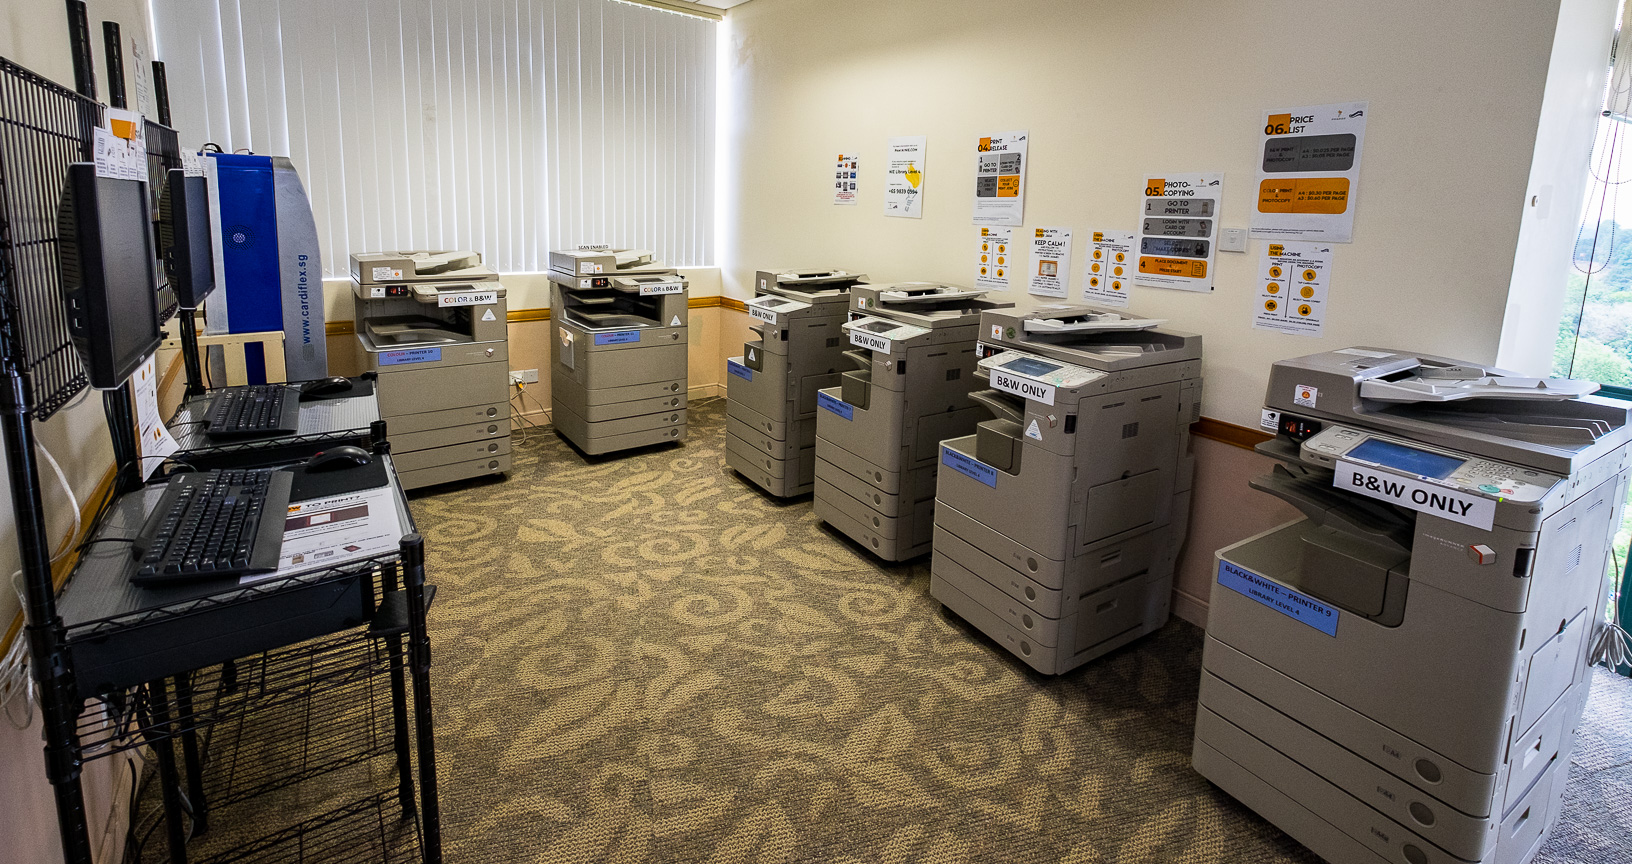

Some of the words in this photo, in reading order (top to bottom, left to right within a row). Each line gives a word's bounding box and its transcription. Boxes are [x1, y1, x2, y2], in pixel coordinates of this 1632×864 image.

[1265, 124, 1287, 135] 06.
[1145, 187, 1162, 196] 05.
[298, 254, 311, 344] www.cardiflex.sg
[752, 309, 762, 318] B&W
[762, 313, 773, 321] ONLY
[855, 335, 869, 345] B&W
[870, 339, 886, 349] ONLY
[997, 376, 1020, 390] B&W
[1021, 383, 1046, 398] ONLY
[946, 450, 970, 465] BLACK&WHITE
[974, 464, 990, 475] PRINTER
[324, 496, 360, 505] PRINT?
[1352, 472, 1405, 498] B&W
[1411, 489, 1473, 517] ONLY
[1225, 565, 1280, 594] BLACK&WHITE
[1288, 594, 1324, 613] PRINTER
[1248, 588, 1274, 603] LIBRARY
[1275, 600, 1294, 613] LEVEL
